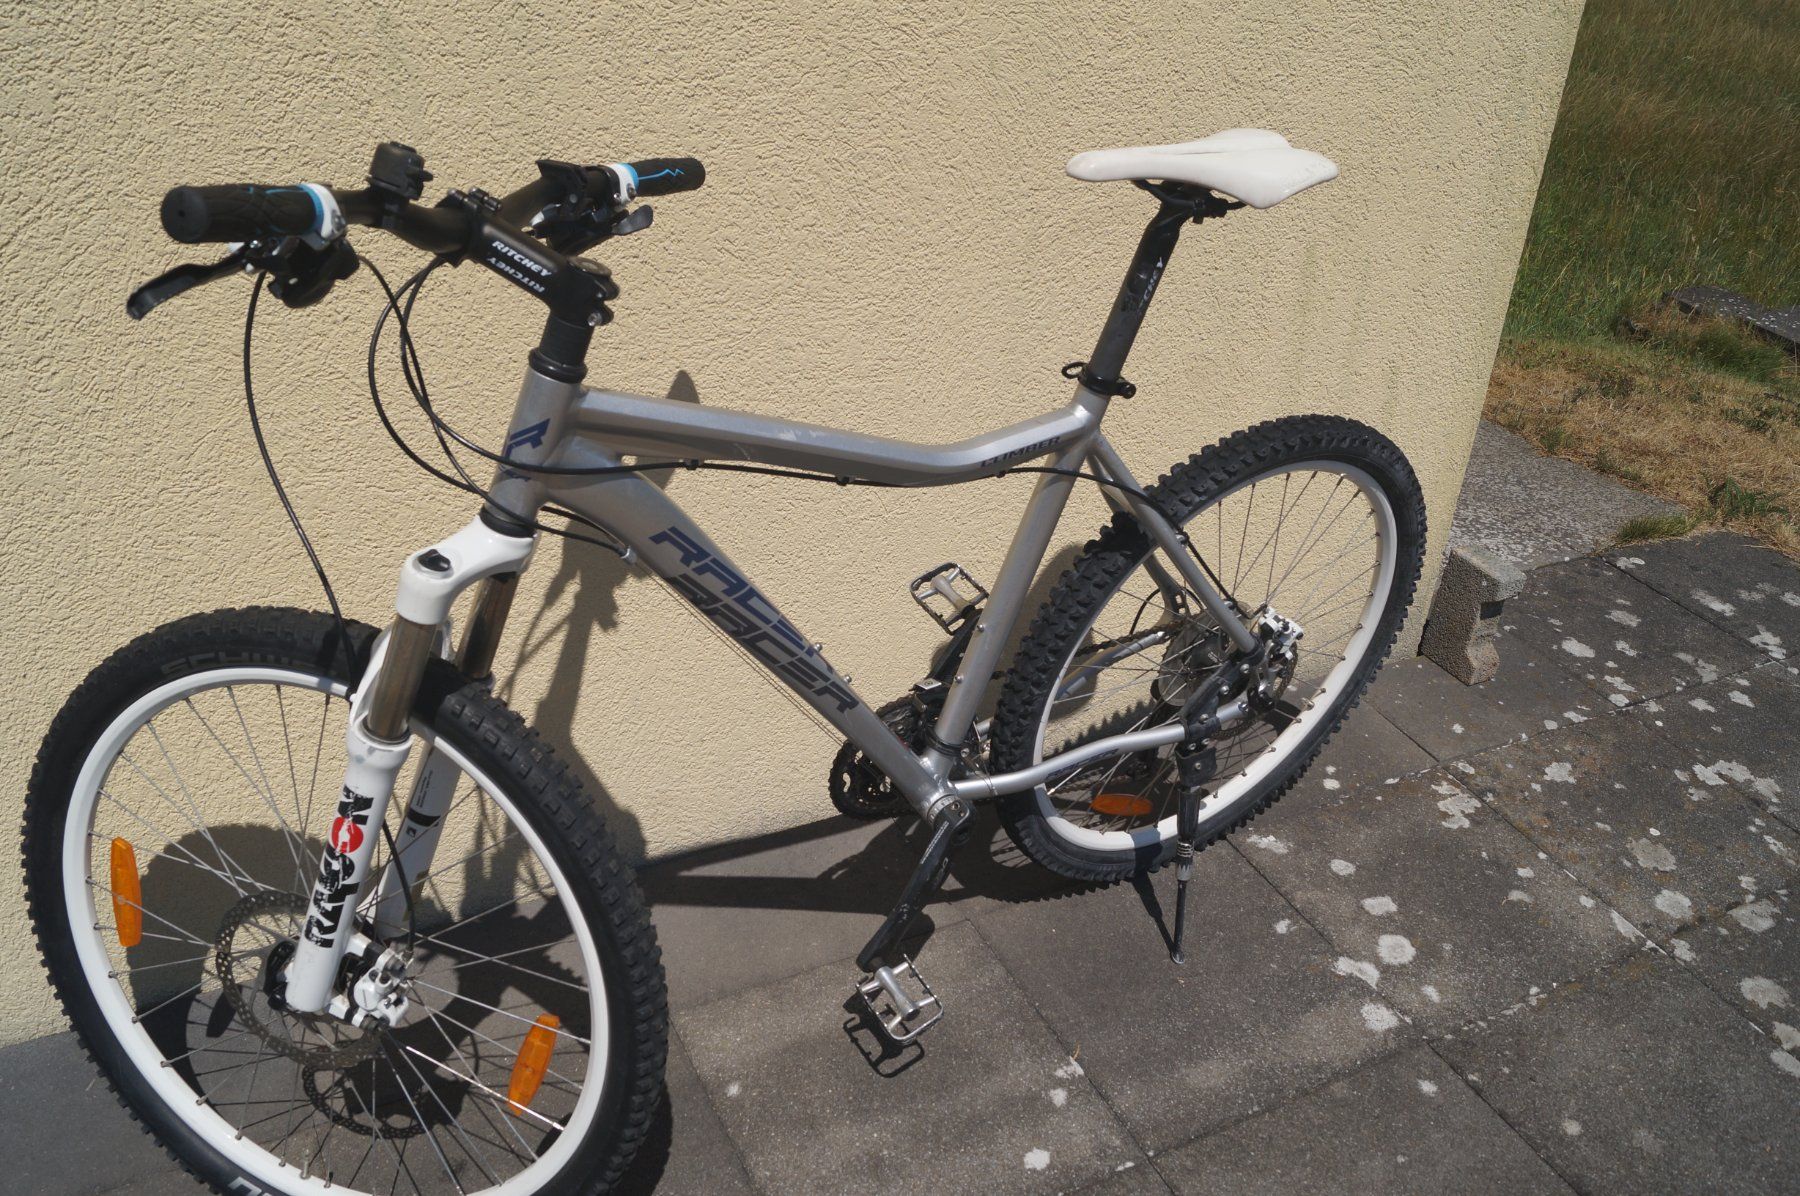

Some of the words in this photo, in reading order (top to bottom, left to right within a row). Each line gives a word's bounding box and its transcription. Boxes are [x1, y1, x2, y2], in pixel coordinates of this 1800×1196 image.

[486, 257, 546, 293] RITCHEY
[492, 240, 552, 278] RITCHEY
[663, 573, 860, 714] RACER
